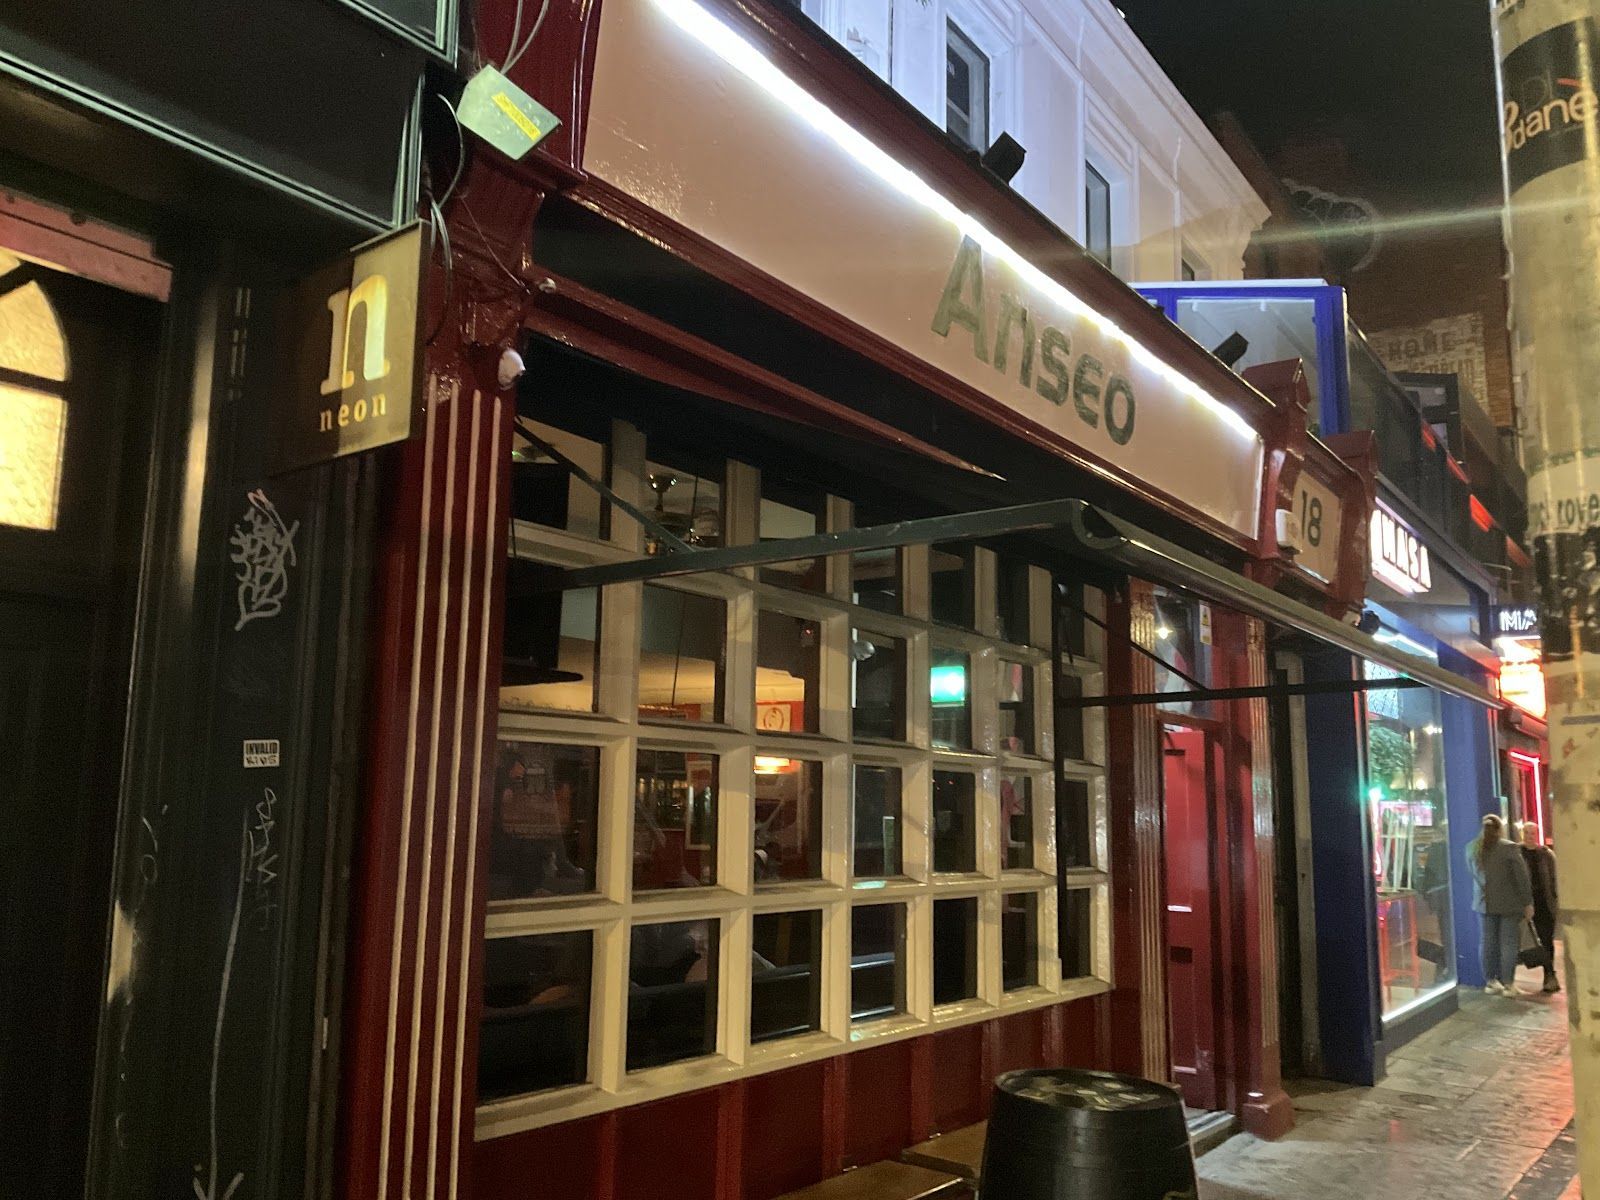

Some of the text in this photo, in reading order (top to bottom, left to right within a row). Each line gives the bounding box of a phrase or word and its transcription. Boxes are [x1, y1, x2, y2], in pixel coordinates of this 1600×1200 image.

[320, 394, 386, 432] neon
[1302, 489, 1322, 548] 18
[246, 742, 278, 755] INVALID
